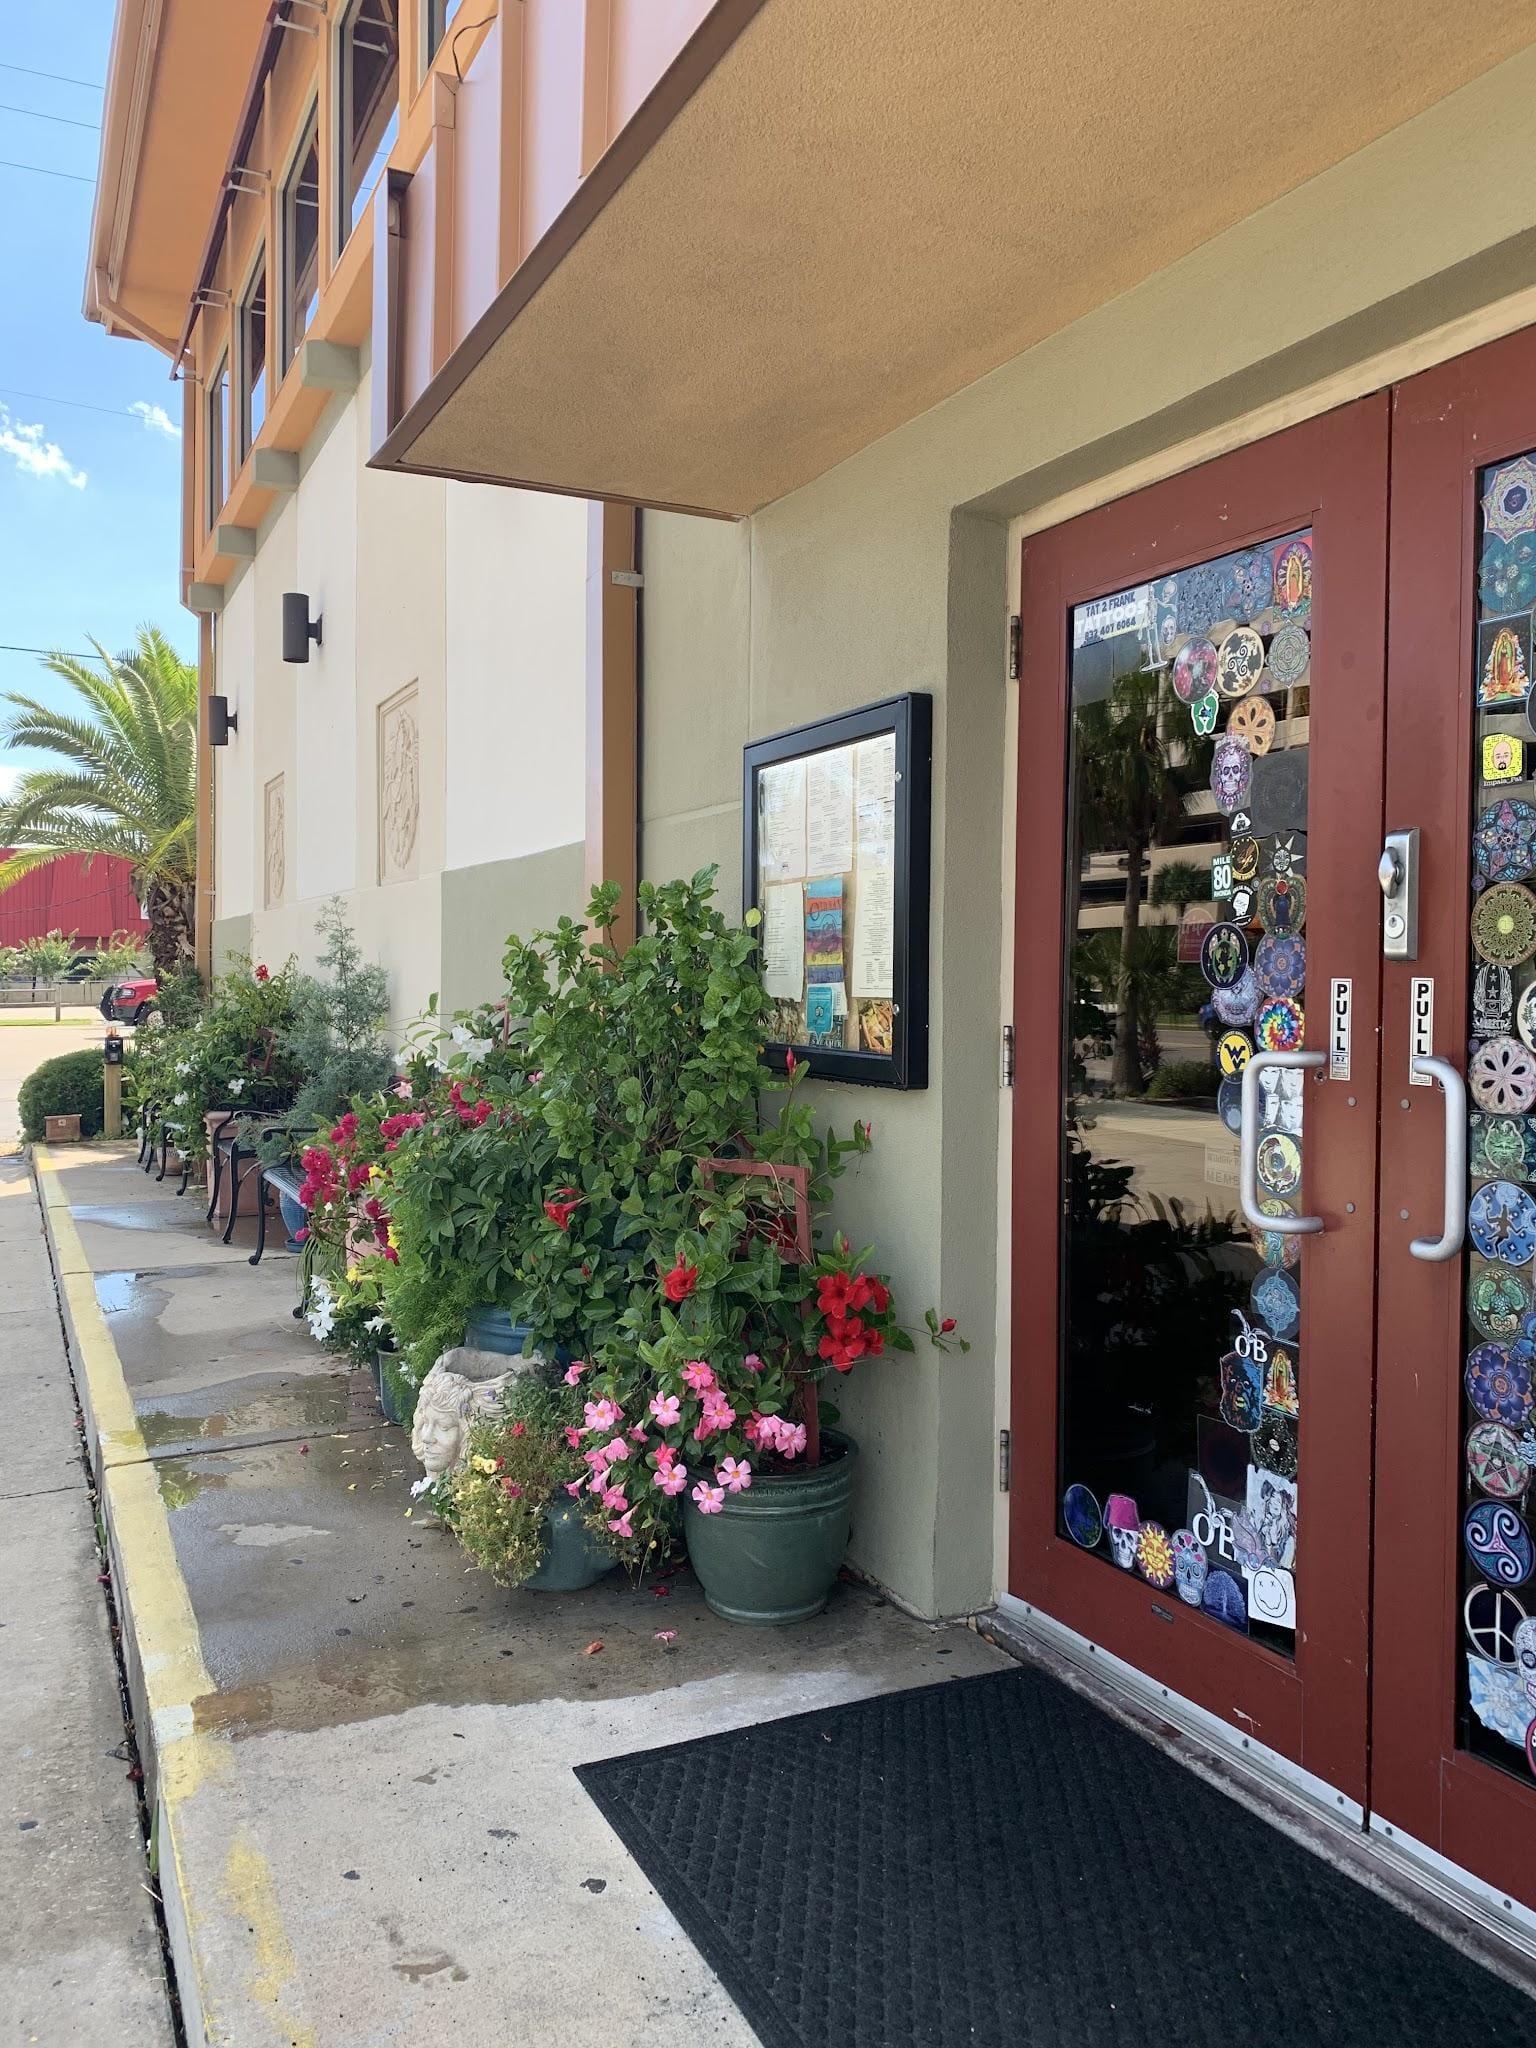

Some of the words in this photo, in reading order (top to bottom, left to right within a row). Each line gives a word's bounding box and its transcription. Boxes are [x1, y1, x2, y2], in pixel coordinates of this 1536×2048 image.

[1086, 604, 1100, 617] TAT
[1102, 602, 1107, 612] 2
[1109, 592, 1136, 609] FRANK
[1100, 622, 1115, 636] 407
[1117, 616, 1137, 631] 6064
[1213, 856, 1231, 866] MILE
[1213, 865, 1231, 890] 80
[1336, 983, 1348, 1051] PULL
[1416, 983, 1429, 1054] PULL
[1206, 1170, 1240, 1186] MEMB
[1234, 1335, 1268, 1363] OB
